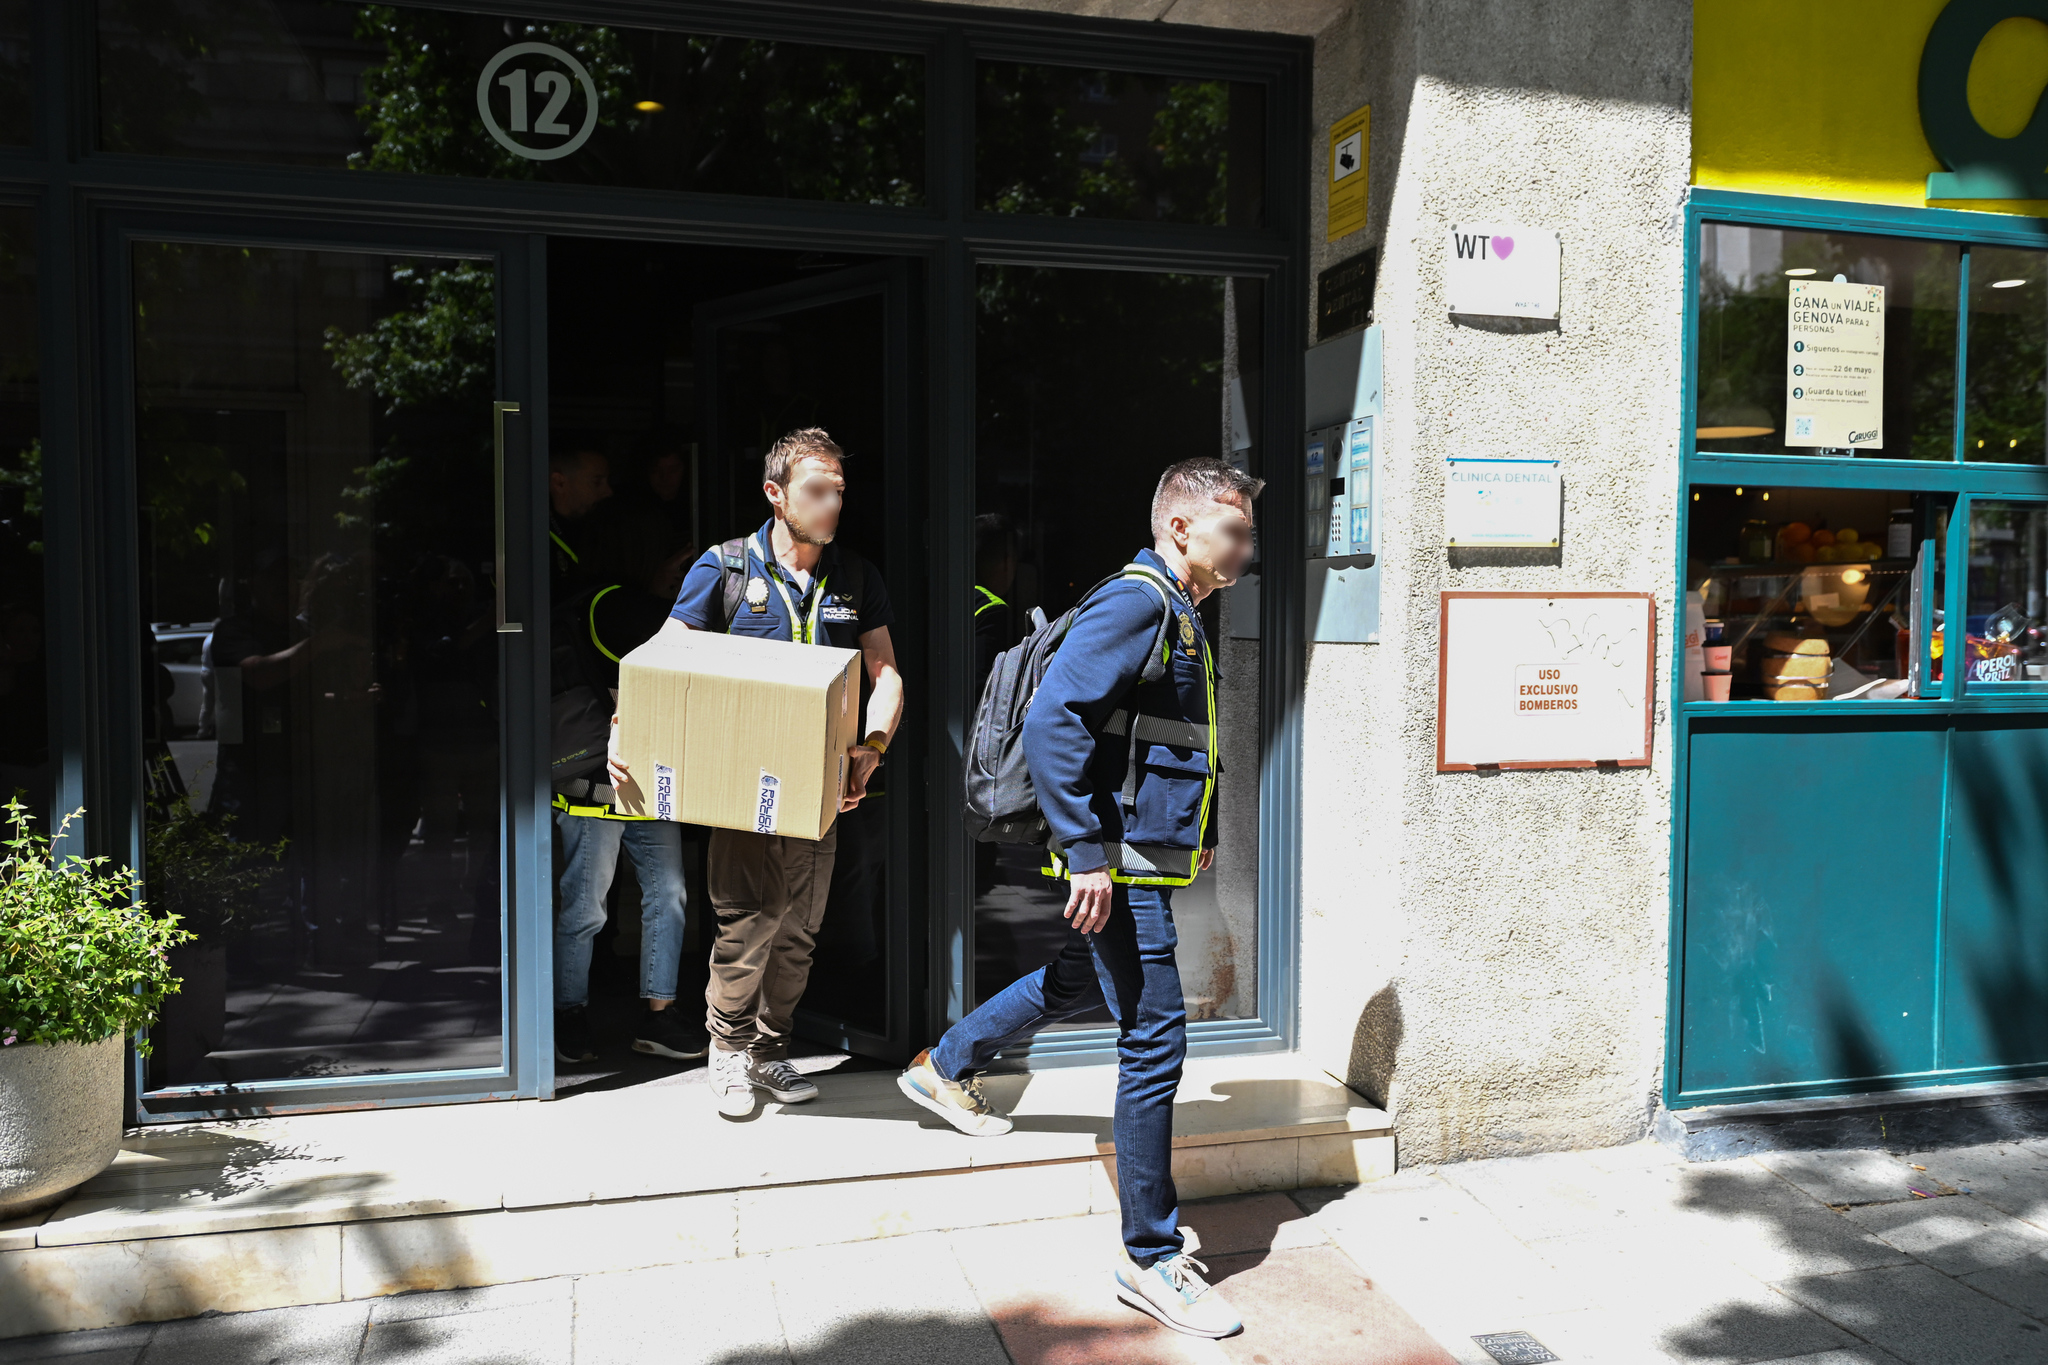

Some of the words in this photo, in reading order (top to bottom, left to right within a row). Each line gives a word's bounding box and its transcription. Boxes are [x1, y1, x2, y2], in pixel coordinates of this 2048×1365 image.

[499, 68, 571, 135] 12
[1455, 233, 1490, 260] WT
[1793, 296, 1828, 309] GANA
[1844, 299, 1875, 313] VIAJE
[1793, 308, 1843, 324] GÉNOVA
[1845, 317, 1864, 326] PARA
[1793, 325, 1835, 333] PERSONAS
[1854, 366, 1872, 375] mayo
[1836, 388, 1843, 396] tu
[1845, 389, 1867, 397] ticket!
[1311, 451, 1319, 462] 12
[1505, 473, 1553, 483] DENTAL
[823, 606, 854, 614] POLICIA
[823, 613, 859, 621] NACIONAL
[1969, 655, 2015, 677] APEROL
[1539, 669, 1560, 680] USO
[1520, 684, 1578, 695] EXCLUSIVO
[1520, 699, 1578, 710] BOMBEROS
